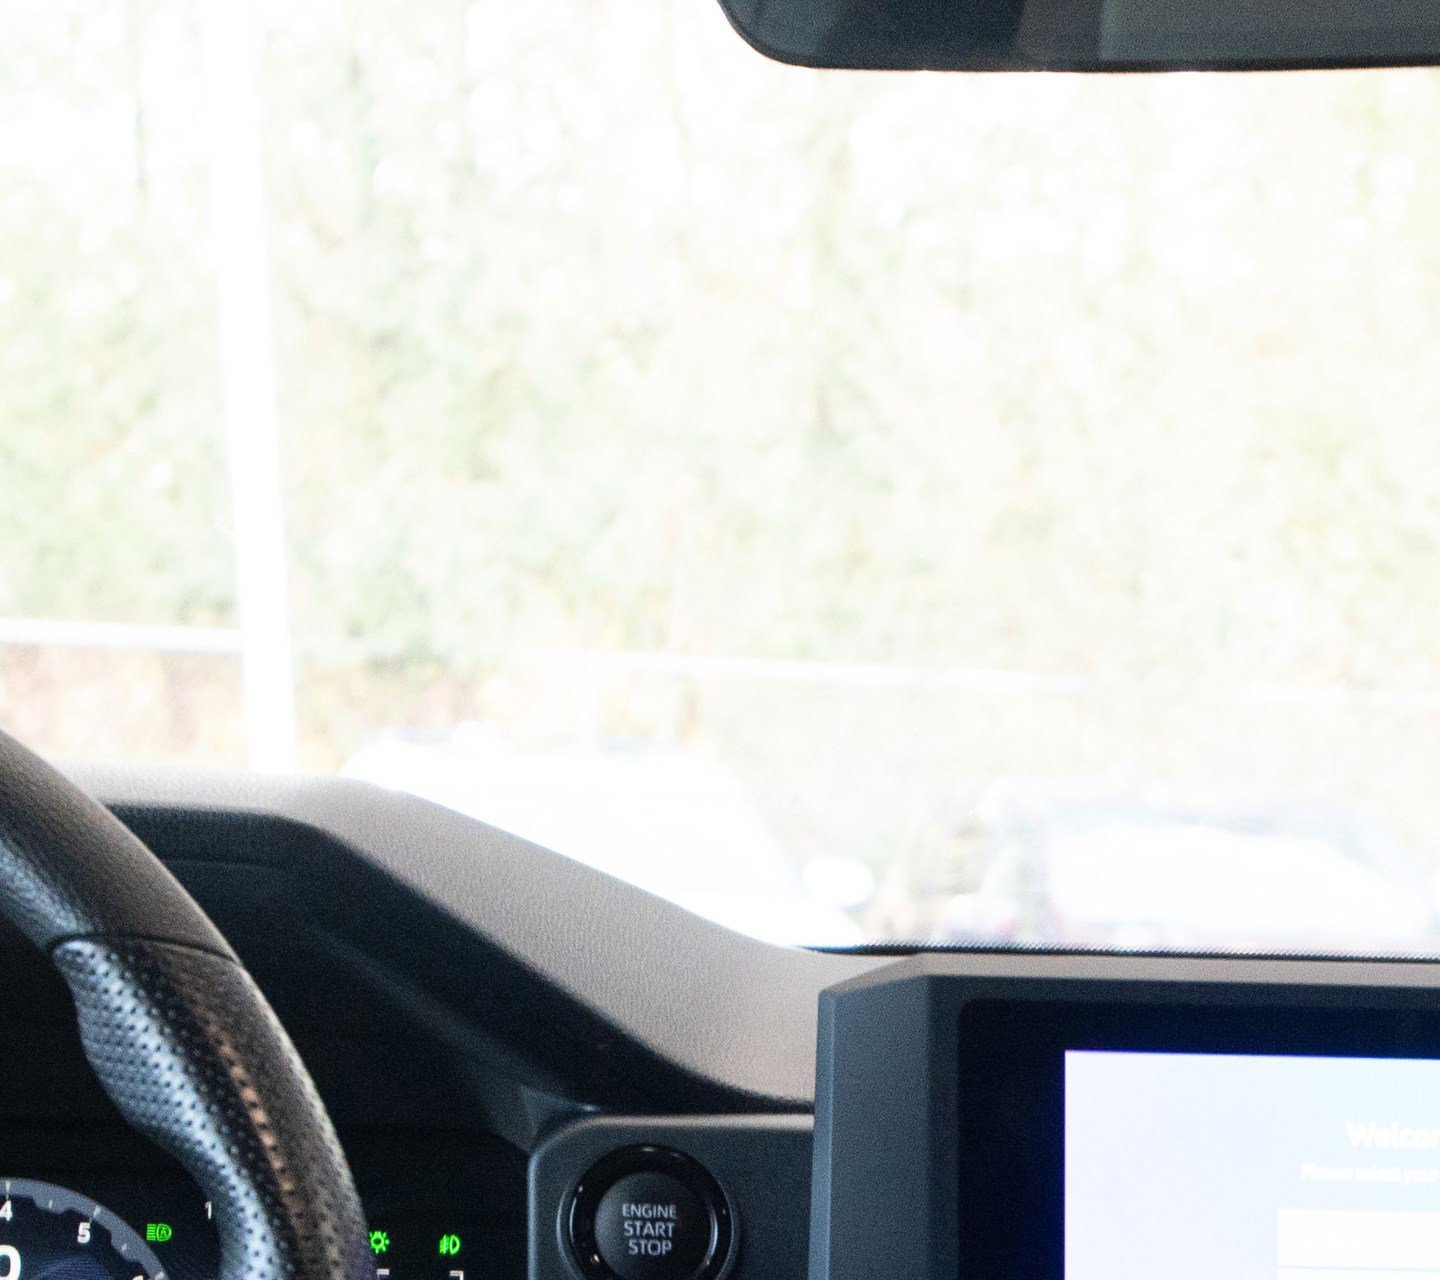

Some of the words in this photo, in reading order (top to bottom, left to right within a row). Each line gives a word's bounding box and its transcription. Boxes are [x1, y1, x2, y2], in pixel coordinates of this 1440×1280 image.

[1301, 1162, 1352, 1181] Please
[1403, 1168, 1438, 1187] your
[621, 1203, 677, 1220] ENGINE
[77, 1222, 91, 1244] 5
[623, 1220, 675, 1239] START
[628, 1238, 673, 1256] STOP
